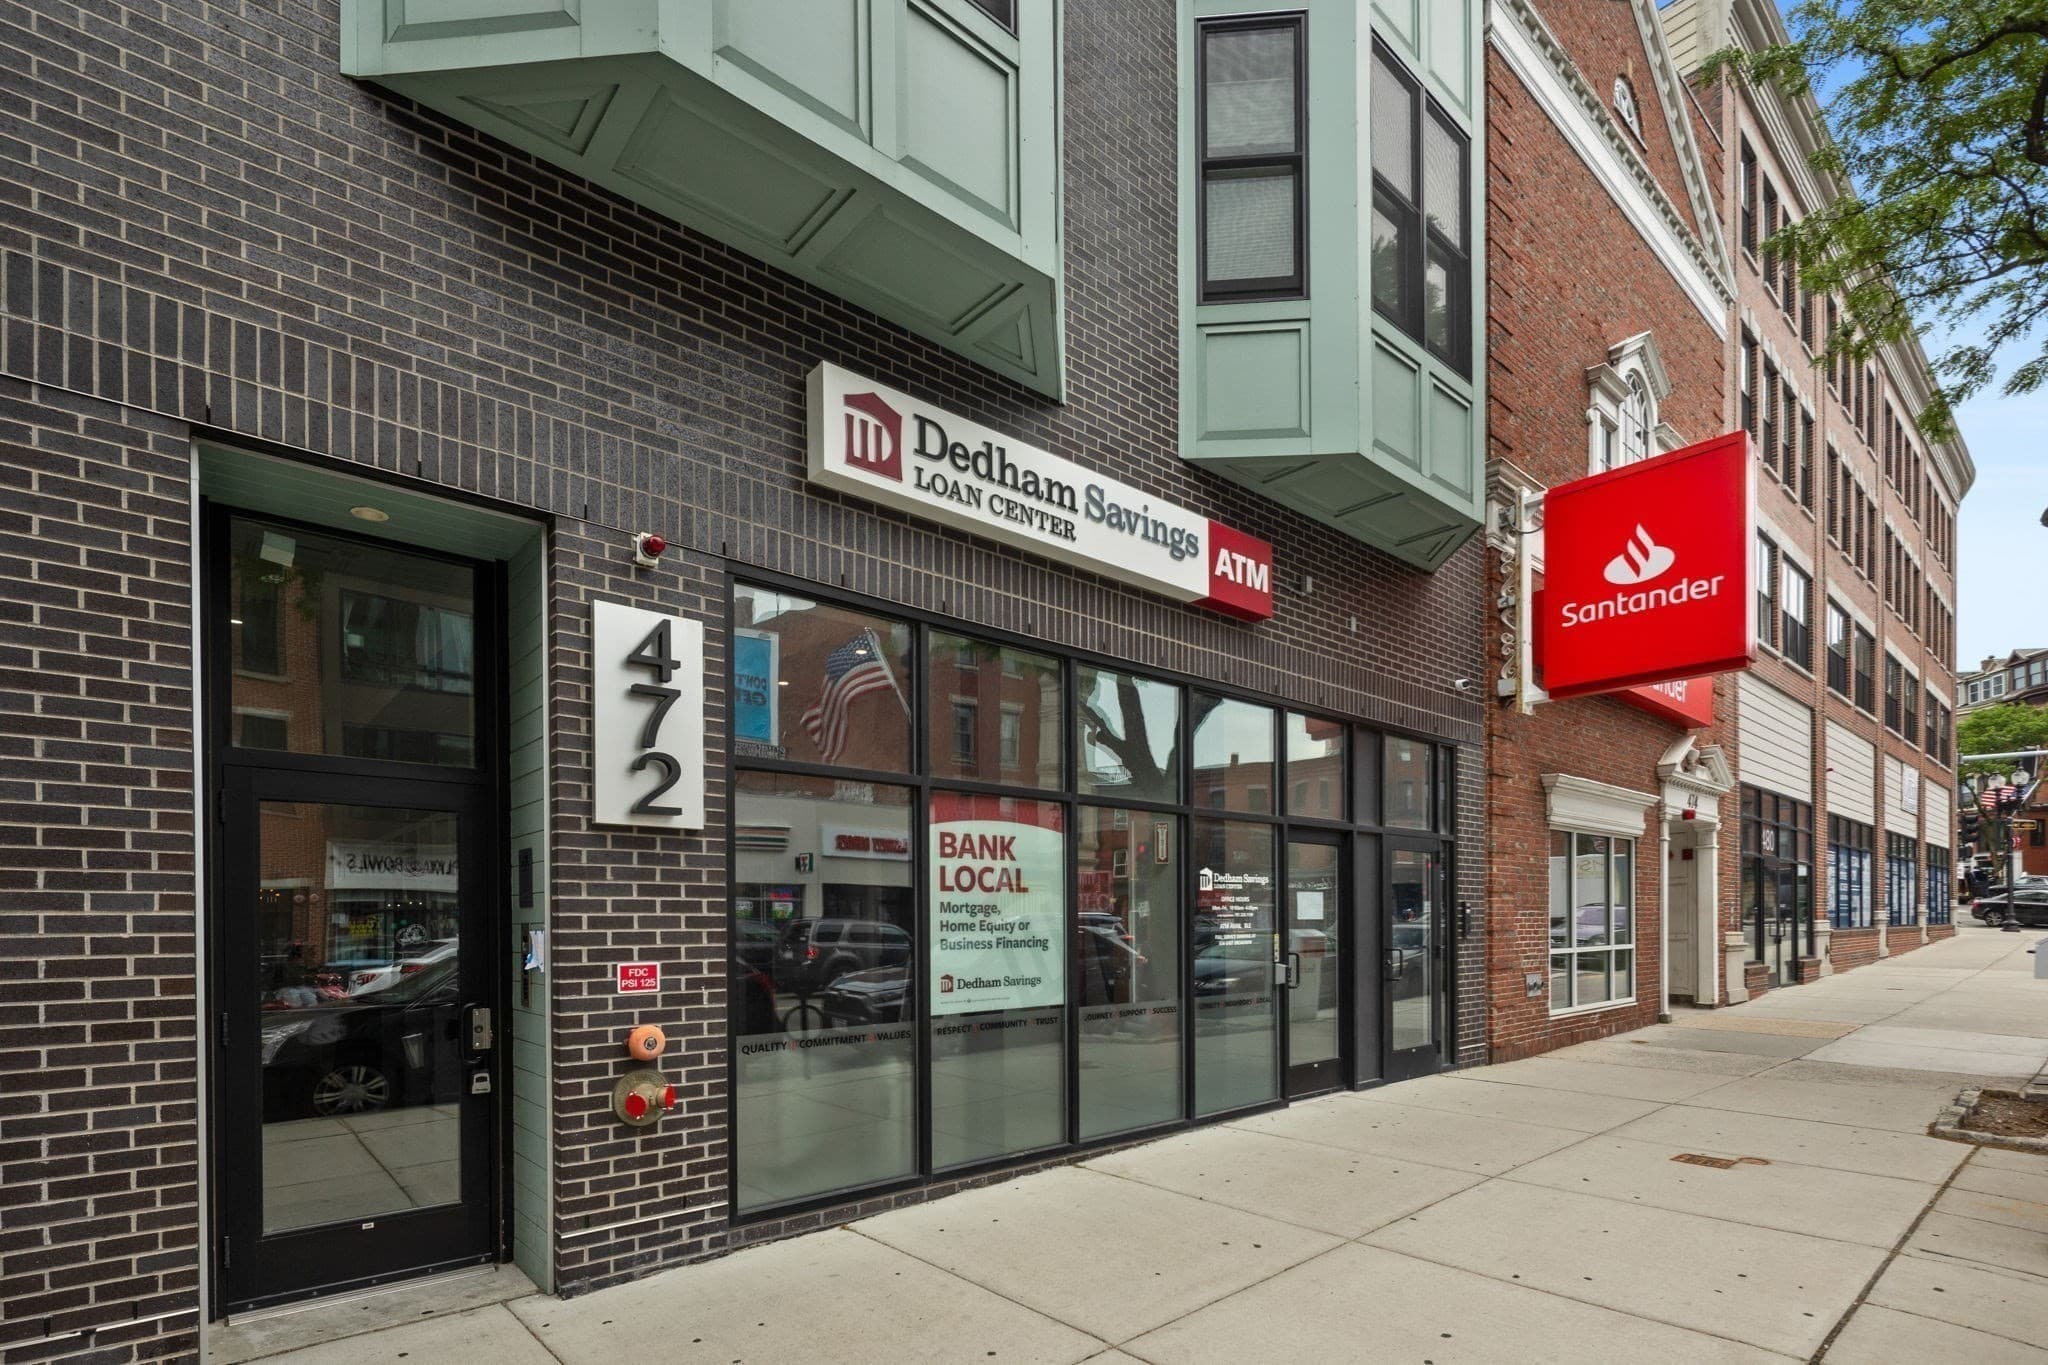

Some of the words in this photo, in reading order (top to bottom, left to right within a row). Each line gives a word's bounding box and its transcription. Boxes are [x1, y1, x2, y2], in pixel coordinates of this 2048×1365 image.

[913, 413, 1079, 513] Dedham
[1084, 483, 1199, 562] Savings
[914, 464, 983, 511] LOAN
[989, 493, 1077, 542] CENTER
[1214, 547, 1269, 594] ATM
[1561, 575, 1724, 628] Santander
[939, 831, 1017, 862] BANK
[1762, 828, 1775, 852] 480
[939, 865, 1029, 894] LOCAL
[940, 901, 1001, 917] Mortgage,
[940, 920, 976, 932] Home
[979, 919, 1016, 935] Equity
[1018, 920, 1030, 931] or
[940, 937, 993, 951] Business
[996, 935, 1049, 951] Financing
[621, 979, 638, 988] PSI
[640, 978, 656, 988] 125
[629, 968, 649, 977] FDC
[957, 977, 1002, 990] Dedham
[1003, 974, 1042, 988] Savings
[1152, 1006, 1177, 1015] SUCCESS
[937, 1024, 971, 1035] RESPECT
[979, 1019, 1027, 1031] COMMUNITY
[1036, 1016, 1058, 1026] TRUST
[741, 1042, 787, 1055] QUALITY
[799, 1034, 866, 1049] COMMITMENT
[877, 1030, 912, 1041] VALUES
